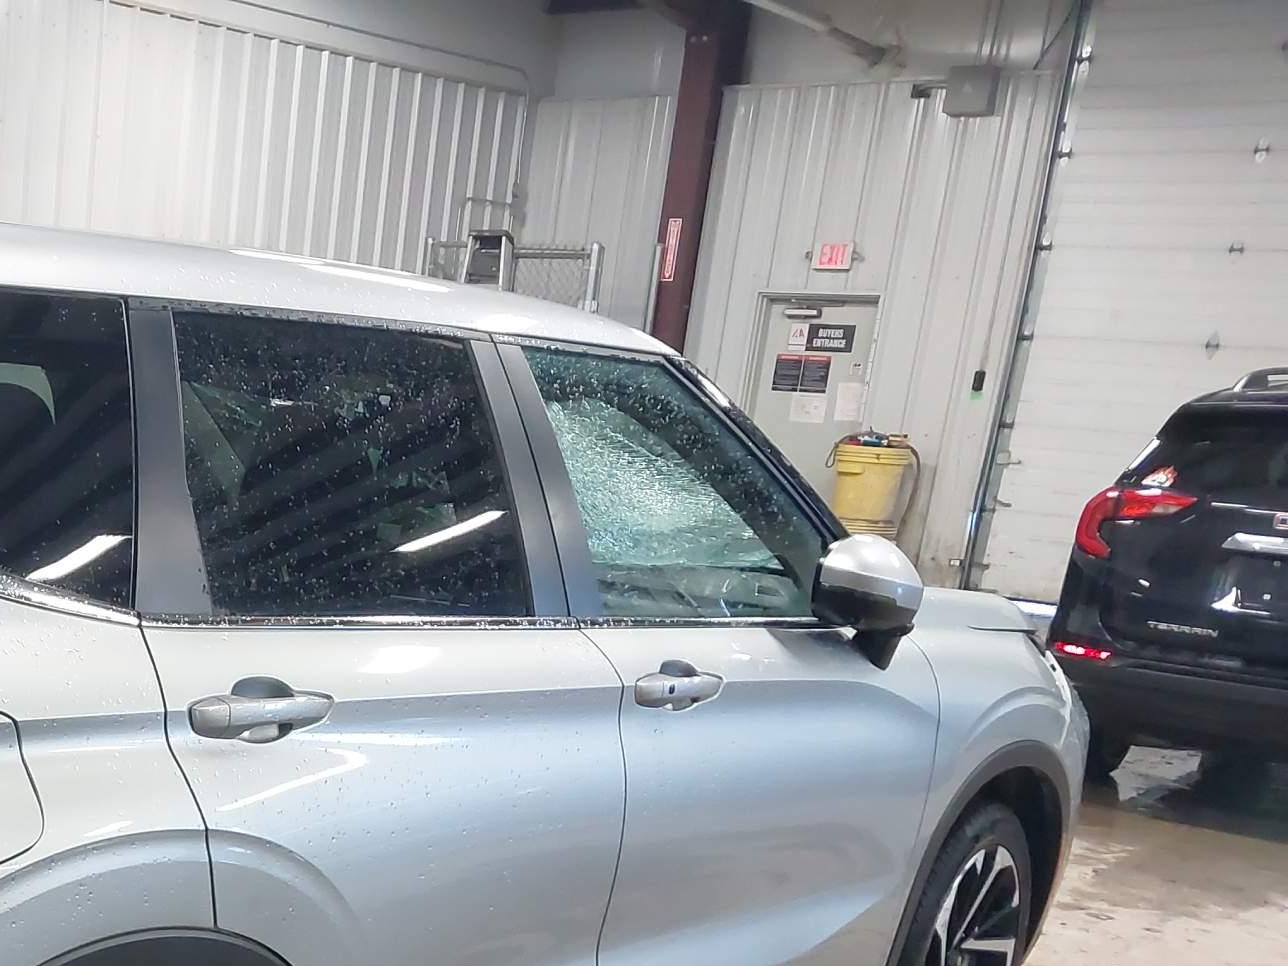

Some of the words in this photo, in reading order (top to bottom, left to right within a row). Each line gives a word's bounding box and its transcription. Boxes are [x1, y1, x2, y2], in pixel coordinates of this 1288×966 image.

[819, 243, 849, 266] EXIT
[812, 338, 847, 348] ENTRANCE
[1146, 619, 1219, 638] TERRAIN
